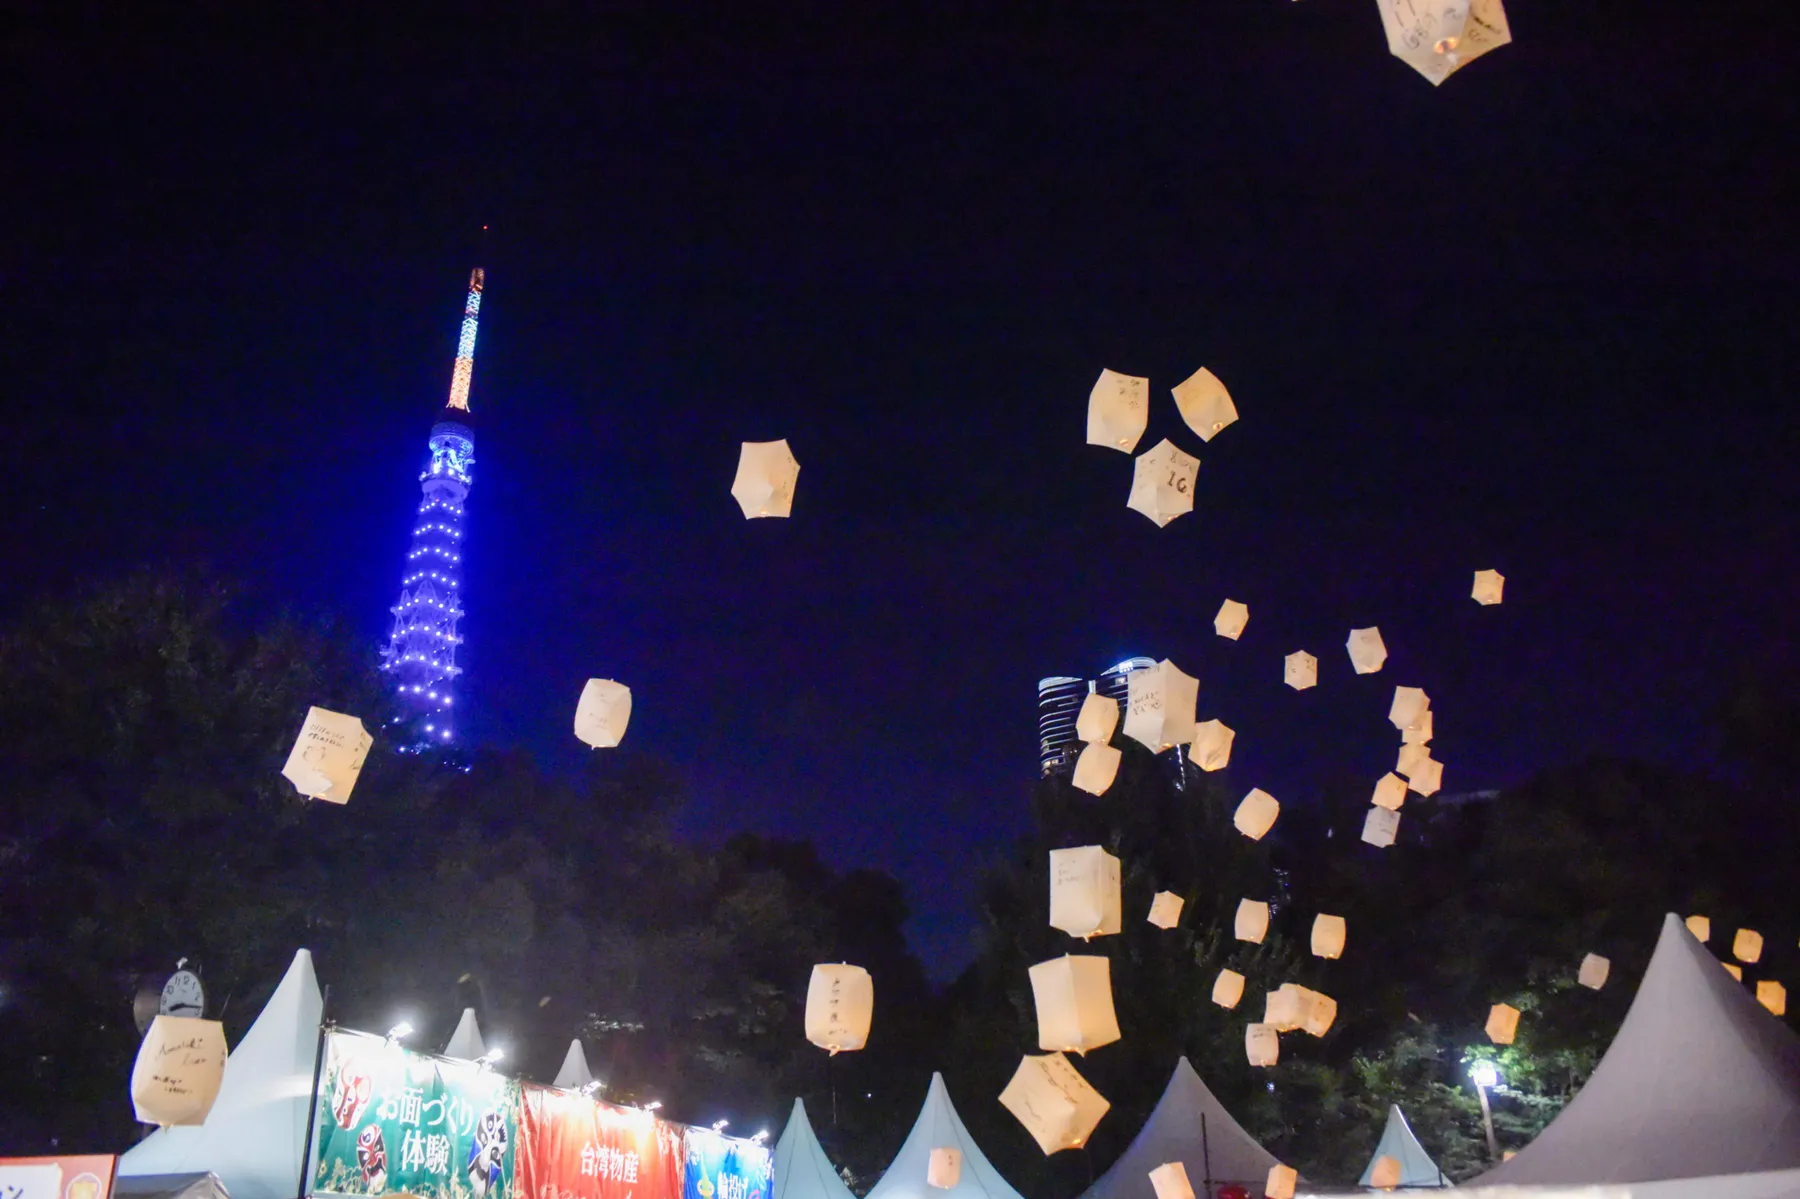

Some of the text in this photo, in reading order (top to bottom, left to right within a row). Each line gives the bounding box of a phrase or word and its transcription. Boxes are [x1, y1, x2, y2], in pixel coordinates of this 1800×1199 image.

[376, 1087, 474, 1137] お面づくり
[401, 1129, 451, 1176] 体験
[580, 1140, 640, 1184] 台湾物産
